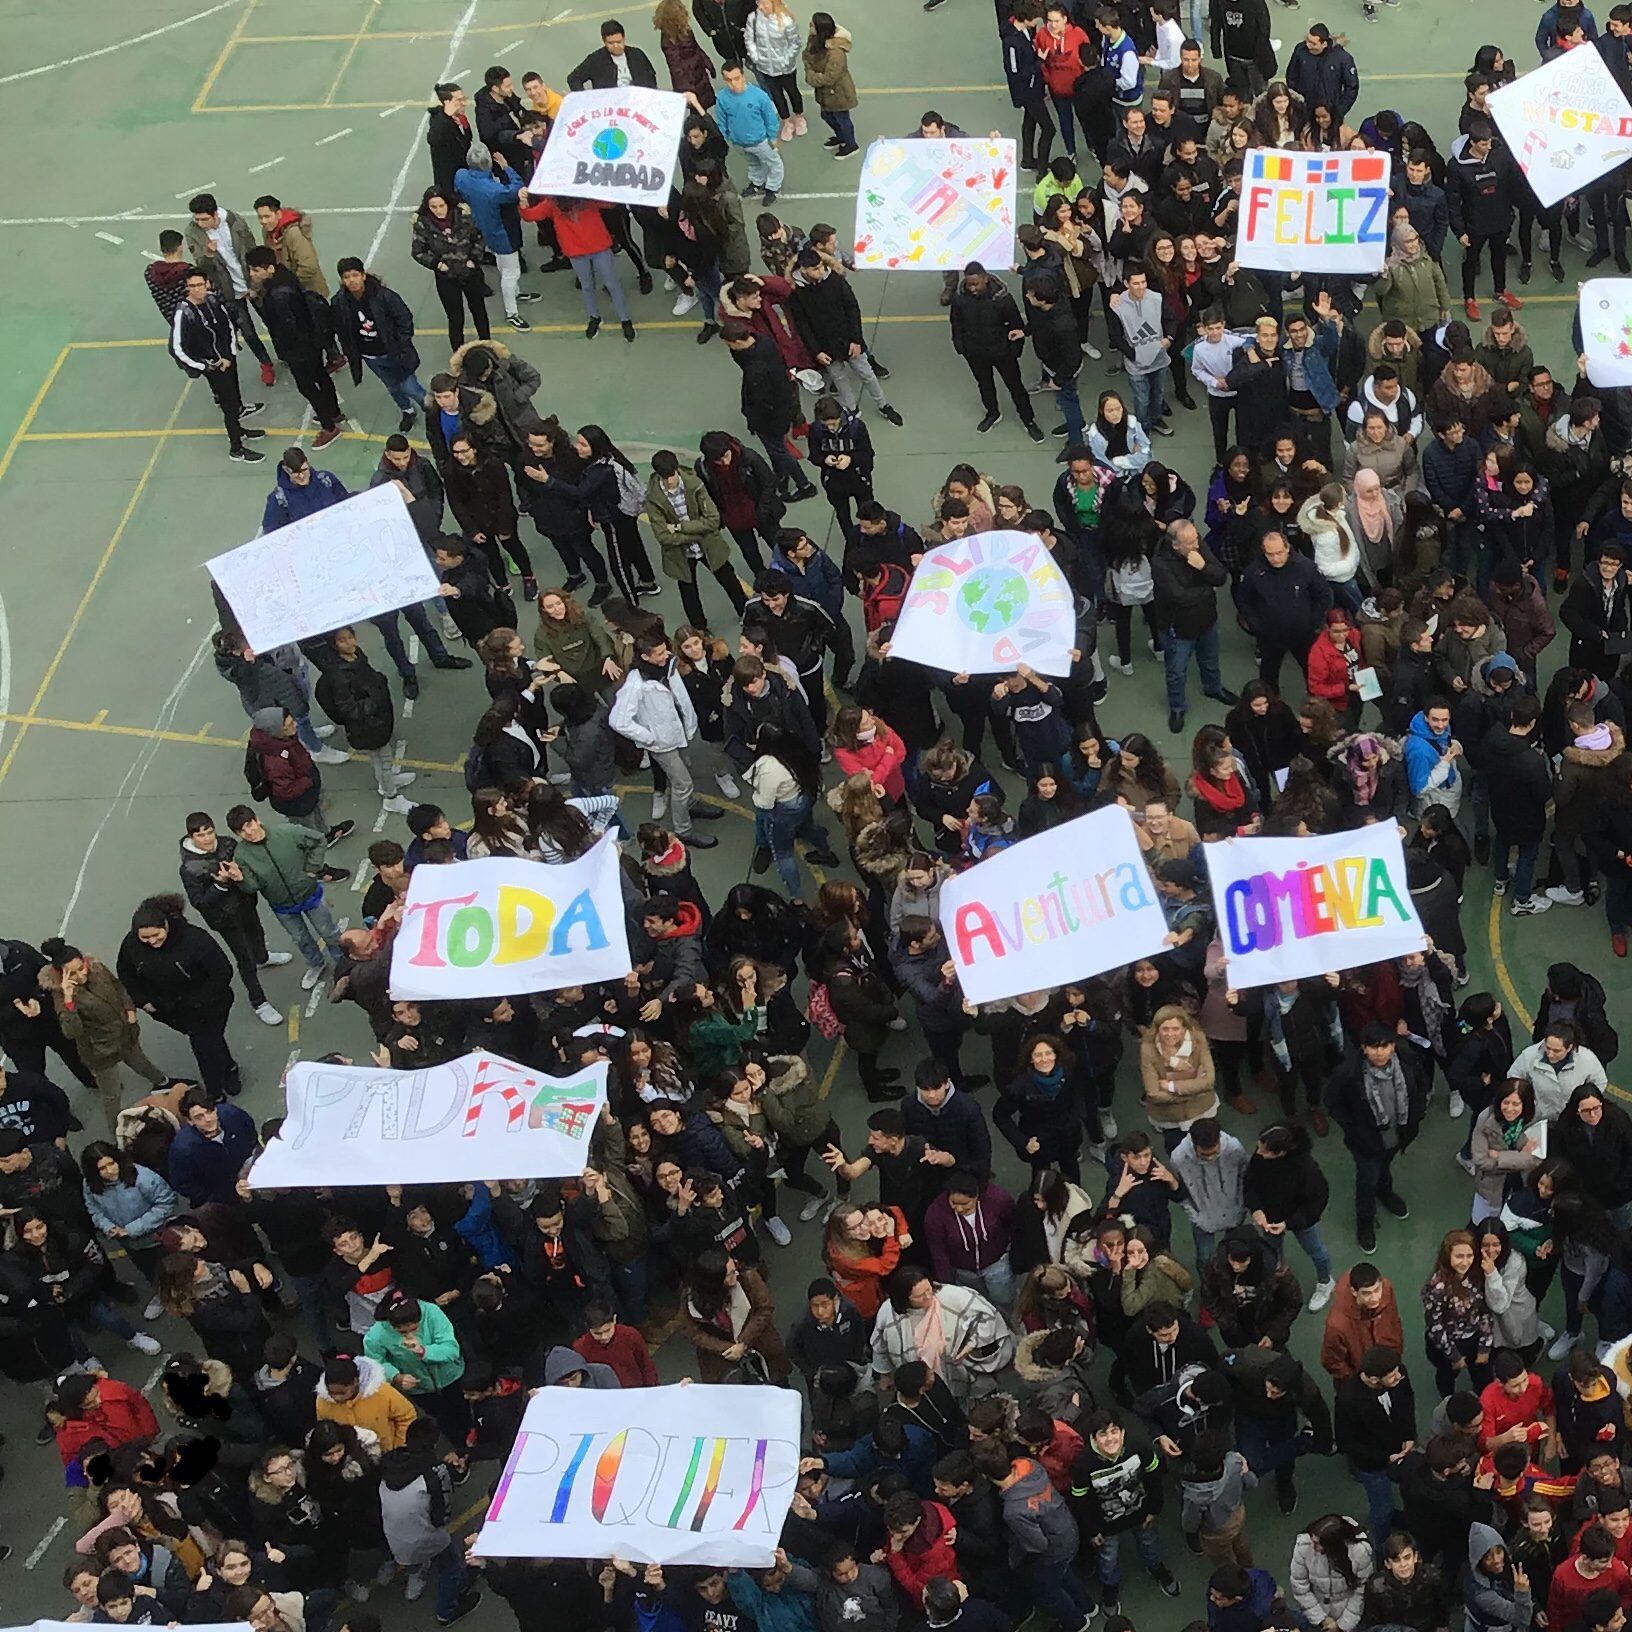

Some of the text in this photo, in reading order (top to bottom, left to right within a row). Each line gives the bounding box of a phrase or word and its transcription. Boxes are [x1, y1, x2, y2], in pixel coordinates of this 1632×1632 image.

[1553, 70, 1606, 95] PARA
[572, 161, 666, 191] BONDAD
[1246, 186, 1386, 244] FELIZ
[408, 885, 610, 968] TODA
[955, 862, 1154, 966] Aventura
[486, 1427, 799, 1533] PIQUER
